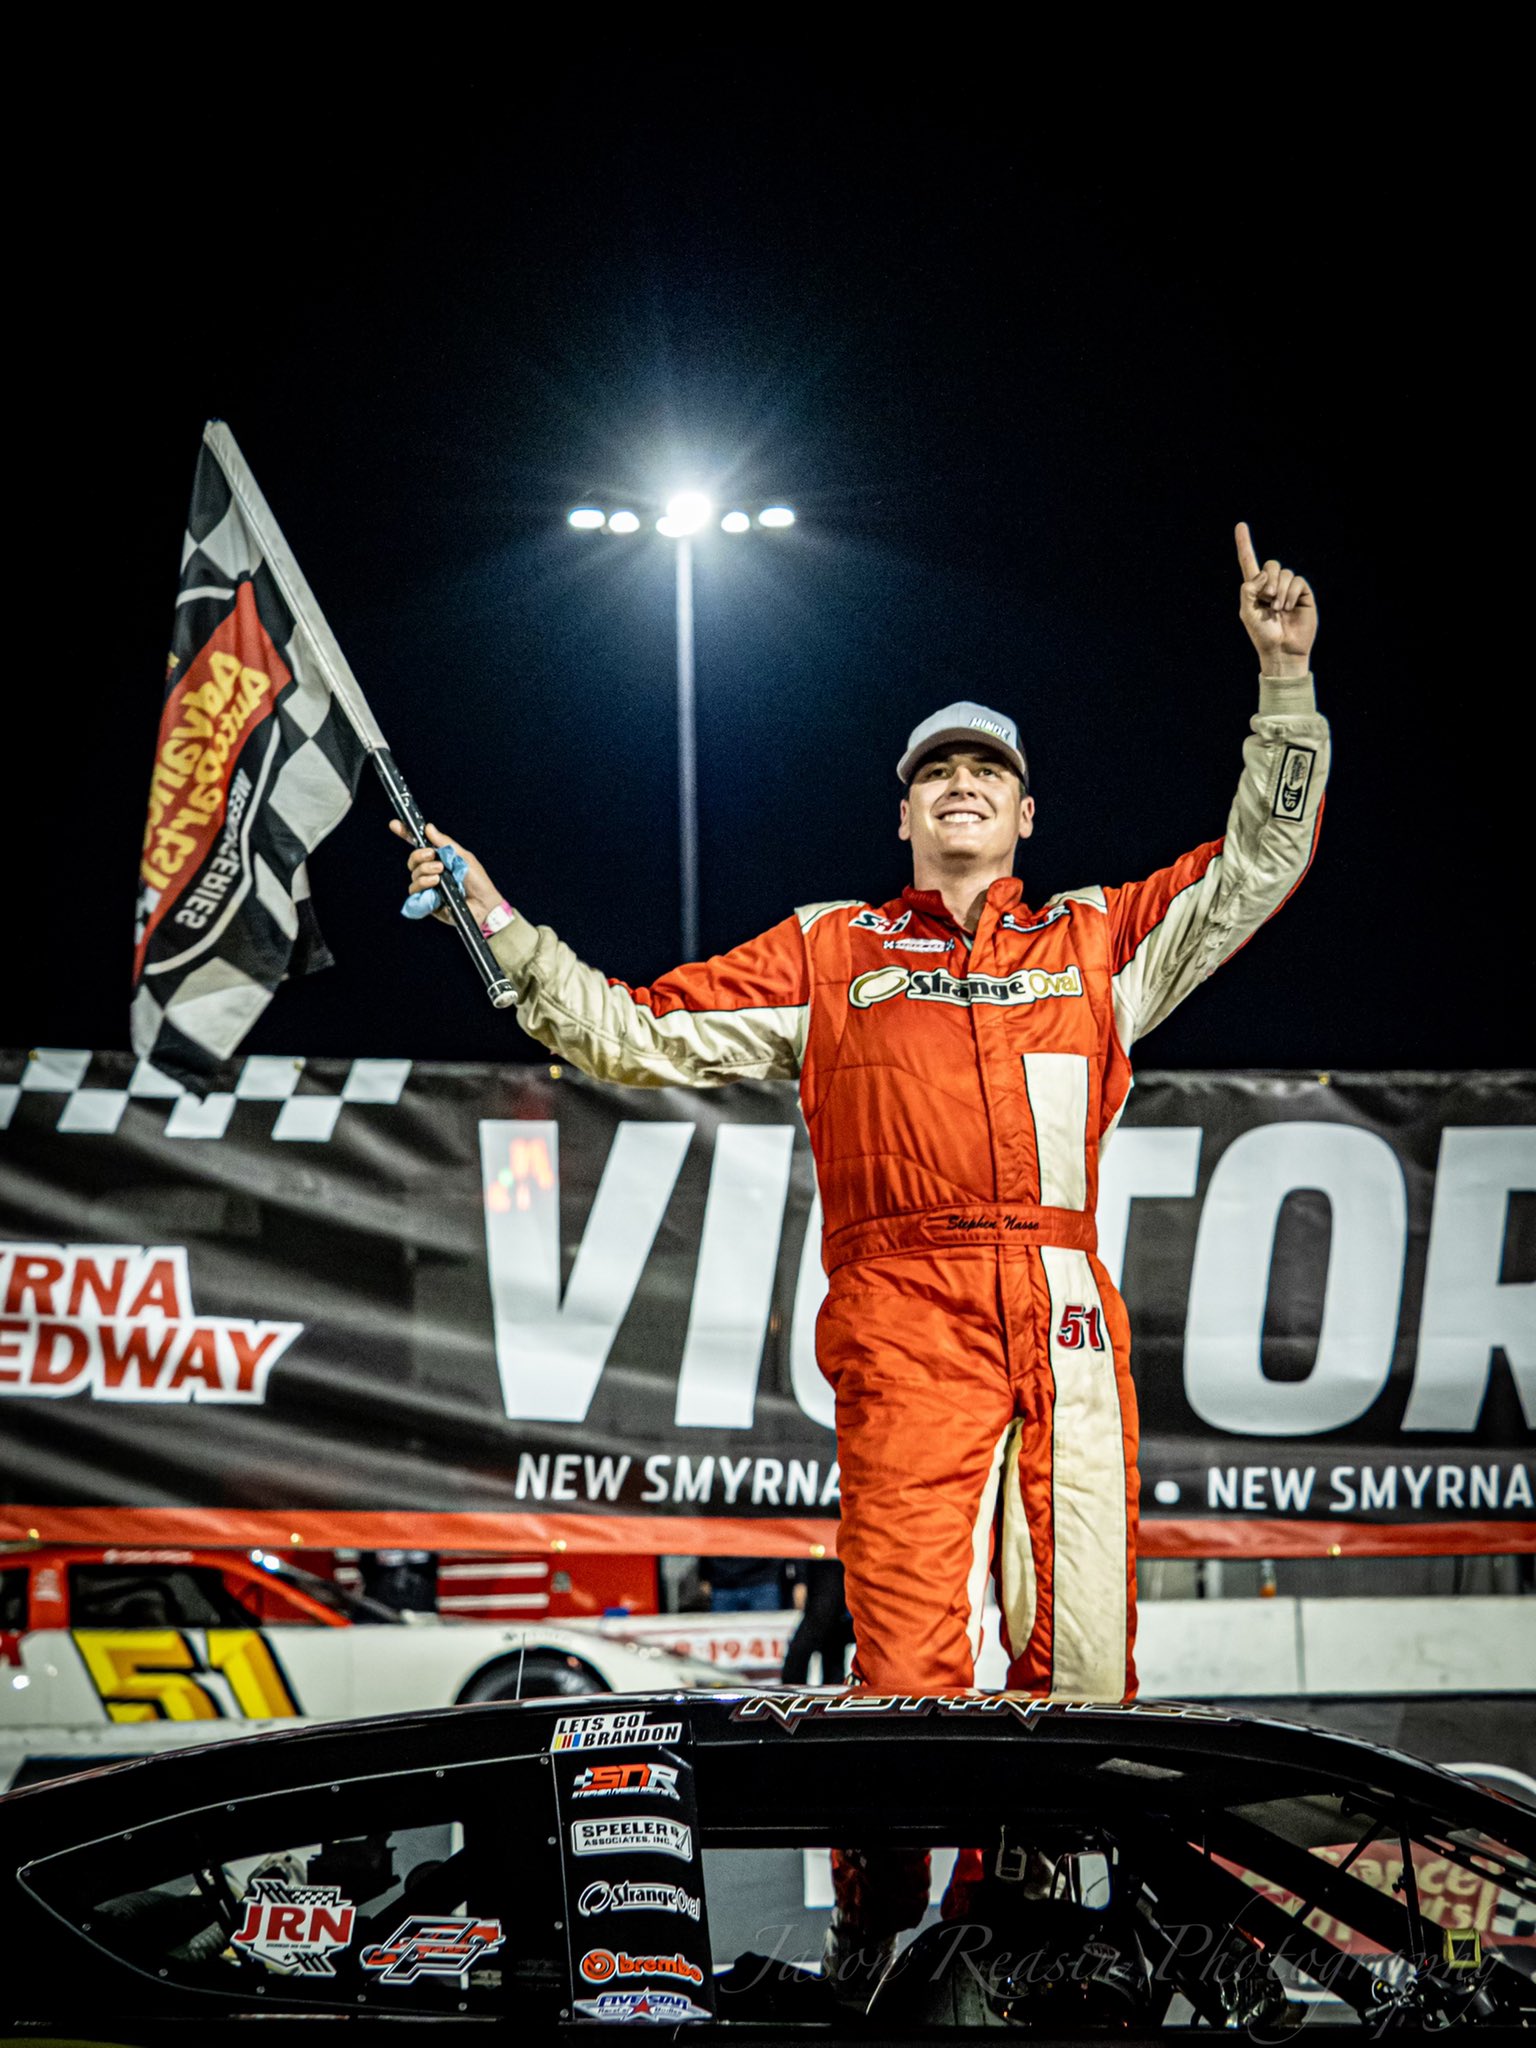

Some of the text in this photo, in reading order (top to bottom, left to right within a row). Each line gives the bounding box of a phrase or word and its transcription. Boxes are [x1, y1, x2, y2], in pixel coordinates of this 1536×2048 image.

[912, 970, 1079, 1000] Strange Oval
[946, 1215, 1040, 1231] Stephen Nasse
[0, 1254, 181, 1319] RNA
[478, 1119, 1536, 1436] VIOR
[1056, 1304, 1105, 1352] 51
[514, 1452, 631, 1500] NEW
[1207, 1463, 1536, 1512] NEW SMYRNA
[72, 1628, 300, 1723] 51
[558, 1714, 641, 1734] LETS GO
[583, 1725, 679, 1747] BRANDON
[582, 1822, 668, 1838] SPEELER
[612, 1881, 677, 1908] Strange
[234, 1905, 349, 1943] JRN
[618, 1953, 703, 1983] brembo
